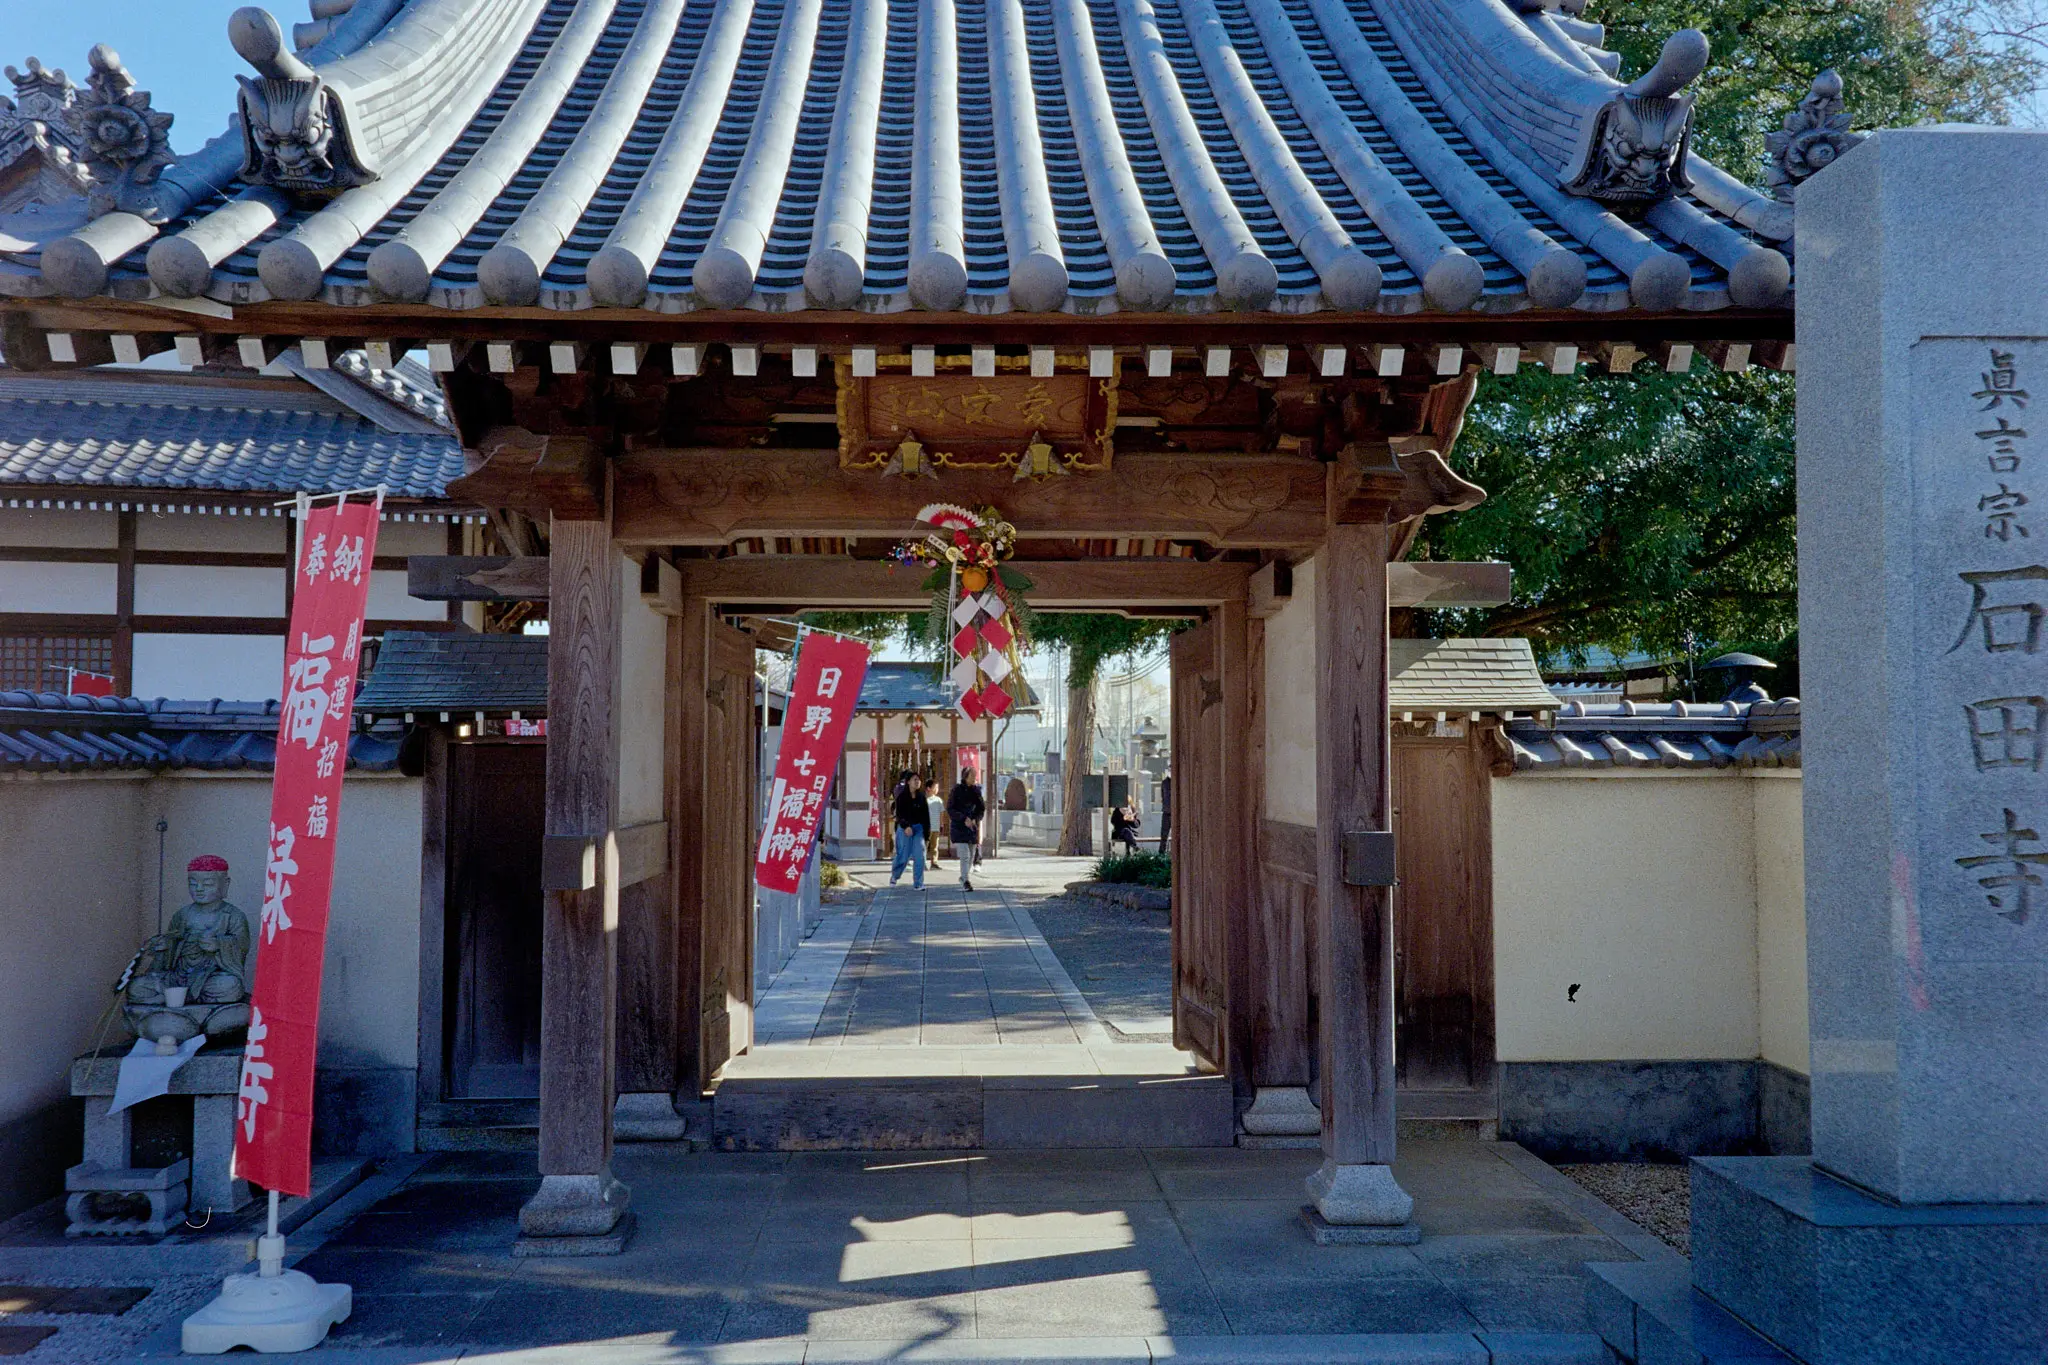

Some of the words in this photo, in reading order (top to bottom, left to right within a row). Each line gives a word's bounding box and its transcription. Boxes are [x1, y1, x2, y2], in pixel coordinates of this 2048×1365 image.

[1971, 349, 2030, 542] 眞言宗
[303, 532, 364, 586] 奉納
[769, 667, 842, 861] 日野七福神
[785, 775, 827, 881] 日野七福神会
[1945, 564, 2048, 925] 石田寺
